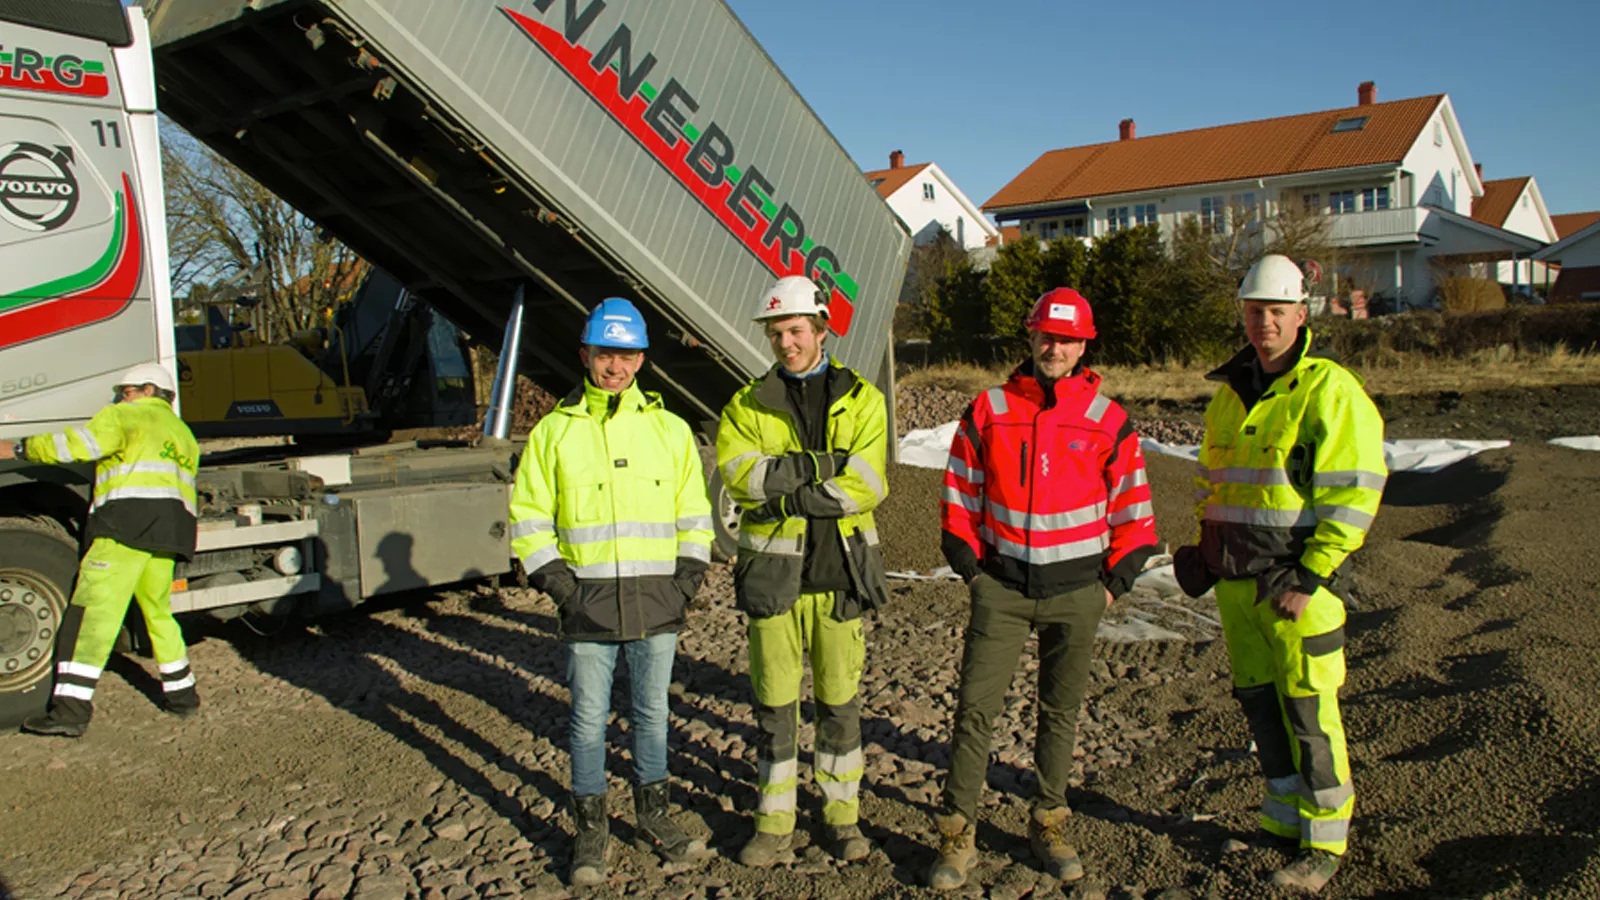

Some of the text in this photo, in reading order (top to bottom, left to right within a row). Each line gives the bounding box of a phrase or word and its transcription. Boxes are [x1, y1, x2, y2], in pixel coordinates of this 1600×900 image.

[0, 45, 84, 87] RG
[90, 120, 121, 148] 11
[1, 373, 47, 393] 500
[236, 404, 271, 413] VOLVO
